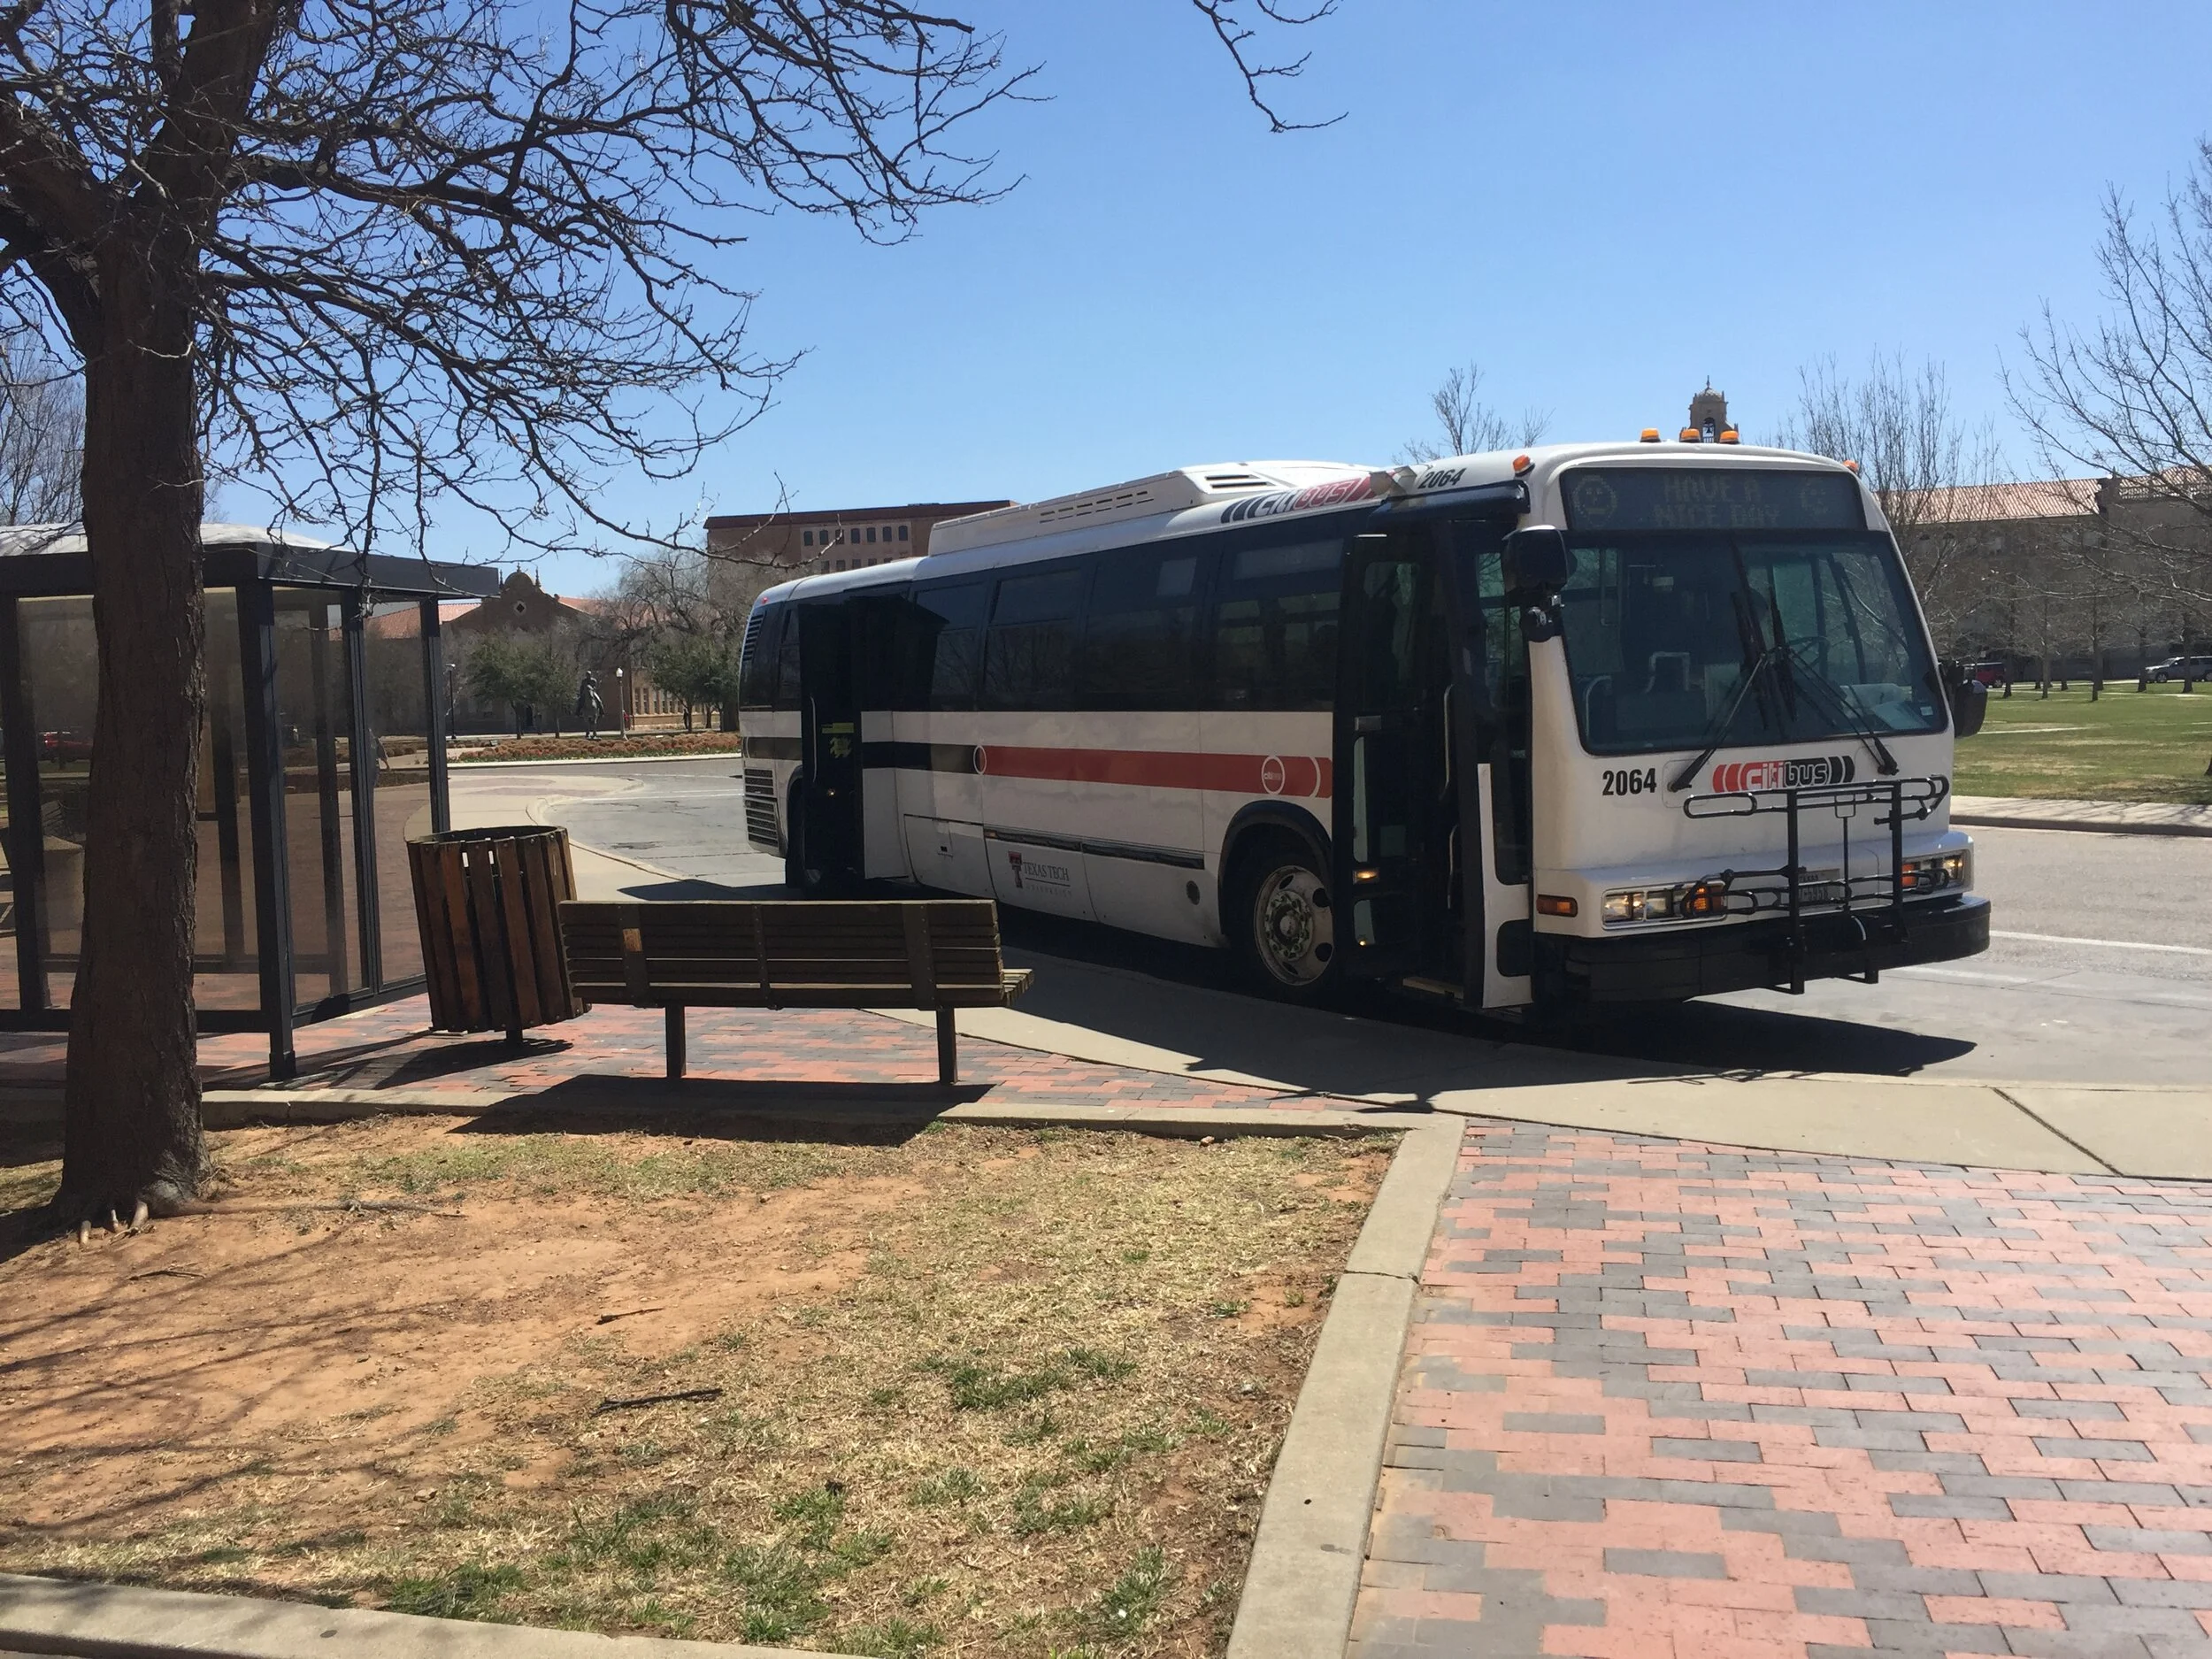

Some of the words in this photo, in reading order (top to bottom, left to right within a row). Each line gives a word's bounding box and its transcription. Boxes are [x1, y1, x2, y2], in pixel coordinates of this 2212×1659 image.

[1418, 468, 1467, 489] 2064
[1664, 476, 1733, 502] HAVE
[1743, 475, 1762, 502] A
[1653, 504, 1720, 528] NICE
[1730, 504, 1779, 528] DAY
[1601, 767, 1657, 796] 2064
[1023, 861, 1047, 879] TEXAS
[1047, 864, 1070, 881] TECH
